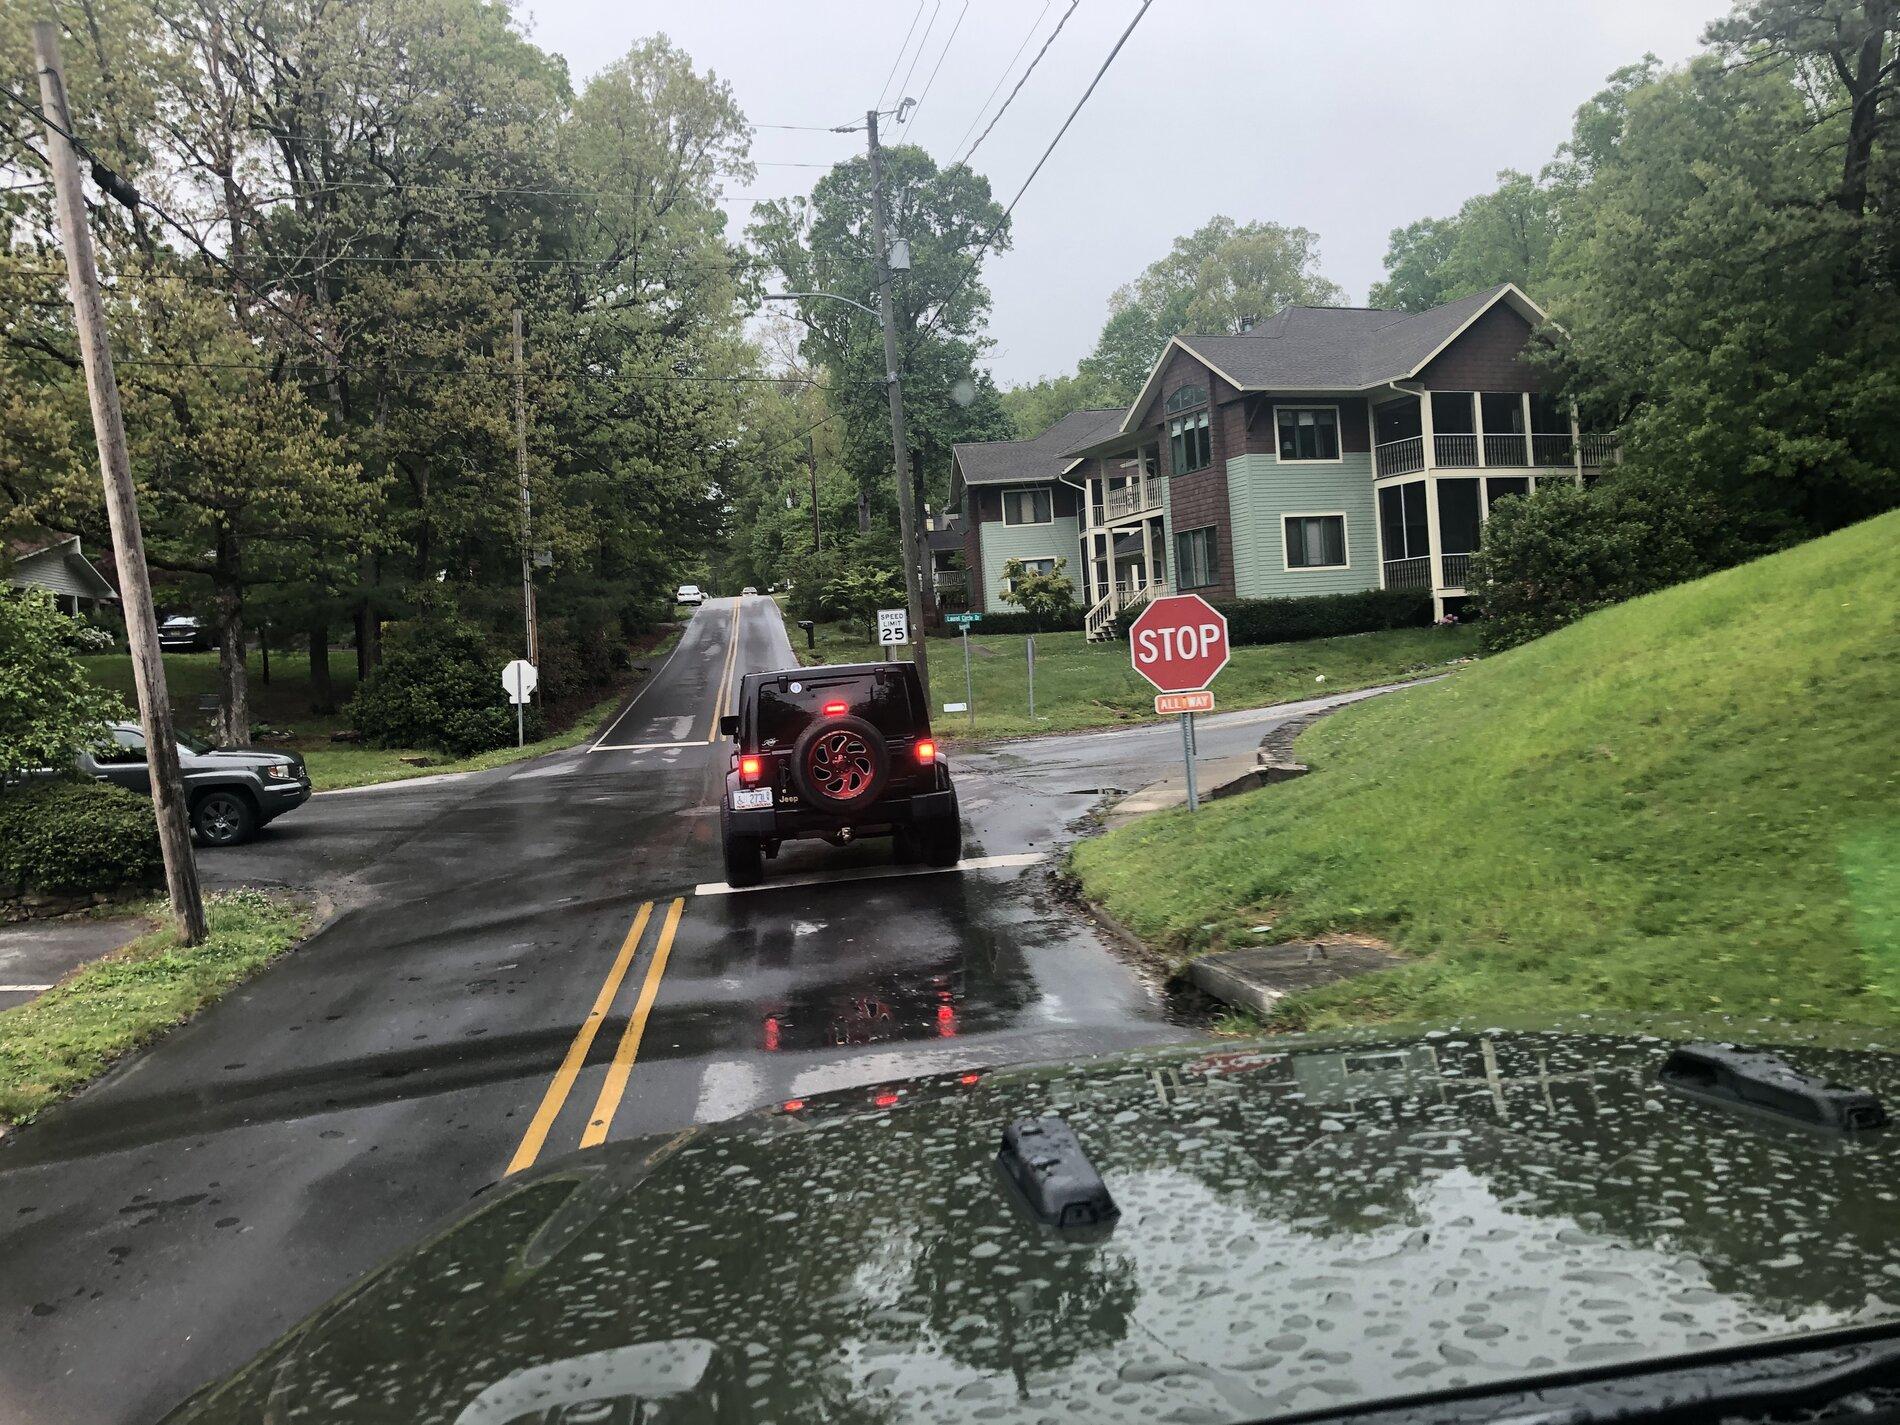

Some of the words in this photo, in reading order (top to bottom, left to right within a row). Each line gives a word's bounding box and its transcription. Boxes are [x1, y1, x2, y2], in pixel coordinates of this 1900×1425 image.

[881, 613, 904, 621] SPEED
[882, 628, 904, 641] 25
[1138, 624, 1220, 663] STOP
[1160, 697, 1182, 710] ALL
[1187, 695, 1209, 708] WAY
[779, 795, 799, 803] Jeep
